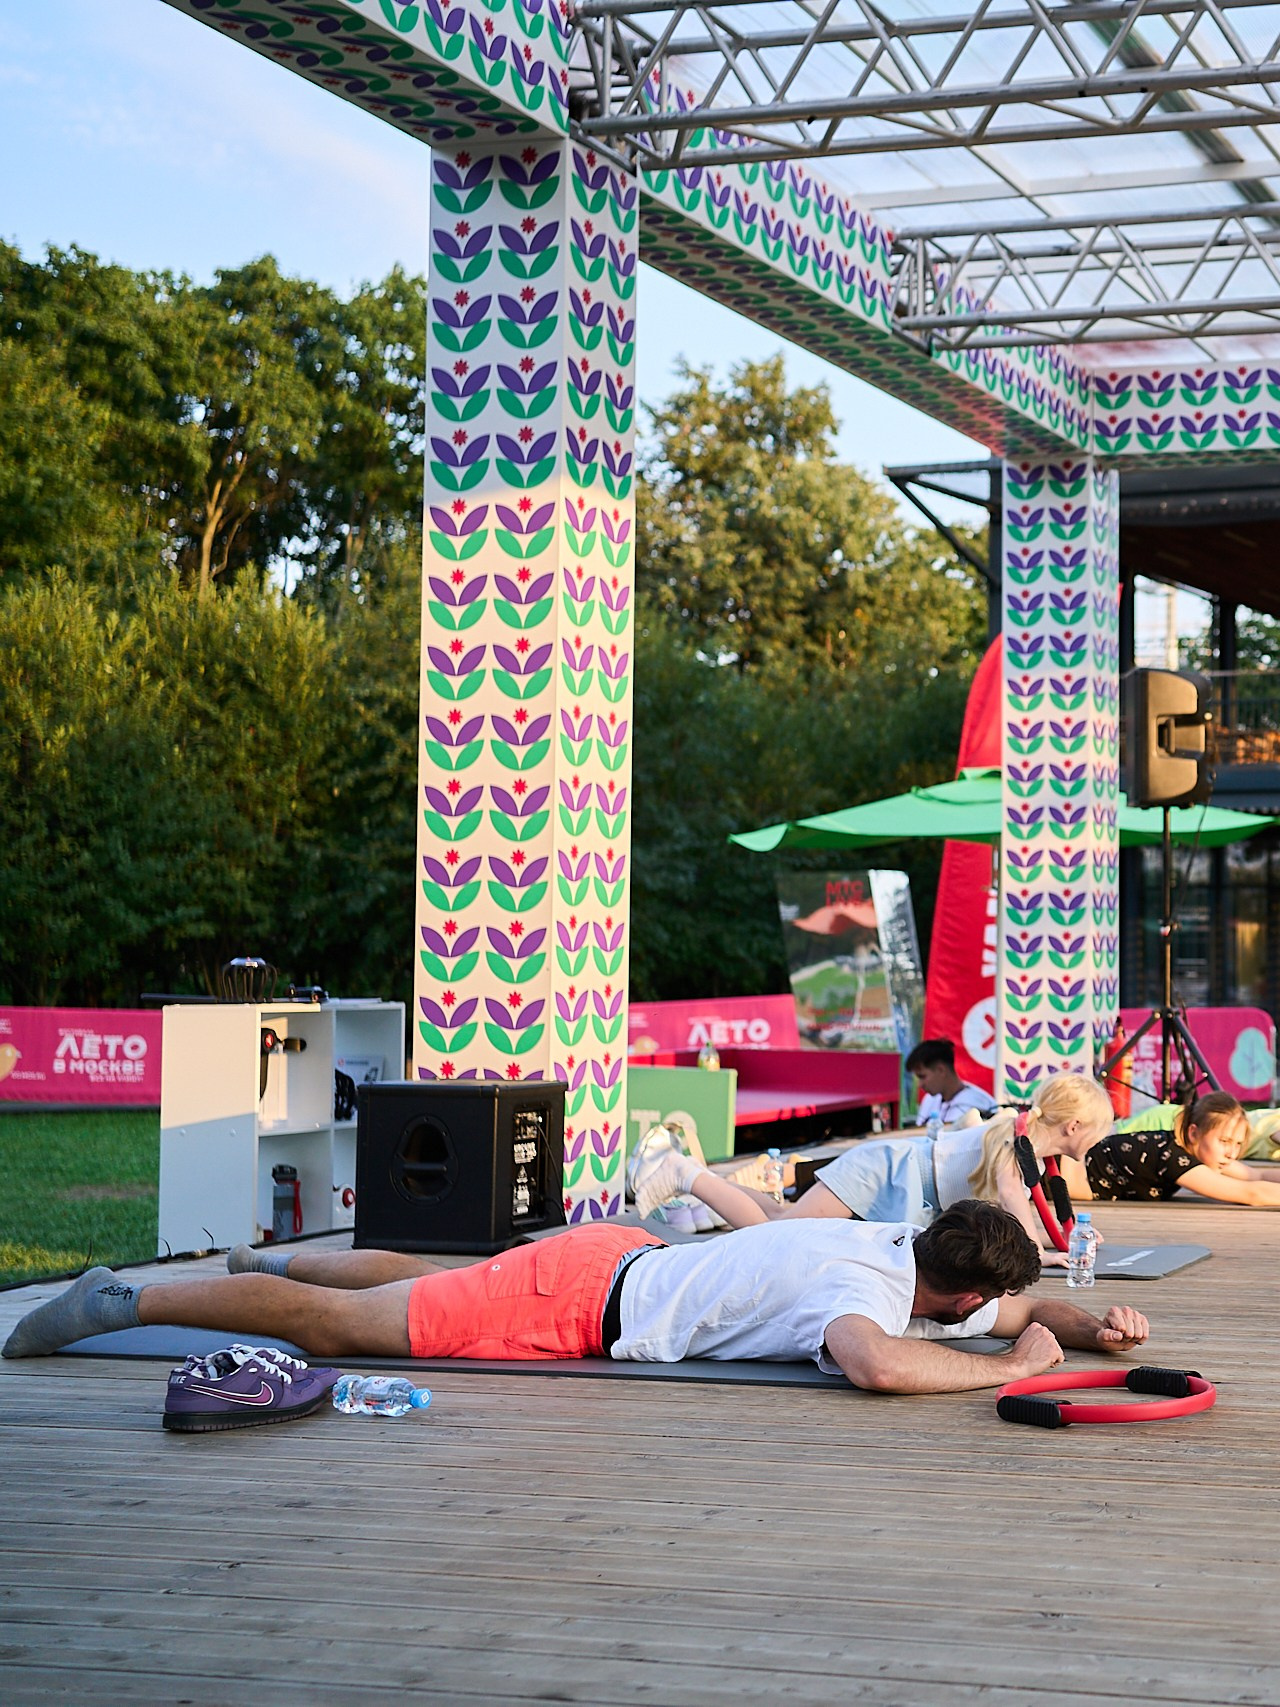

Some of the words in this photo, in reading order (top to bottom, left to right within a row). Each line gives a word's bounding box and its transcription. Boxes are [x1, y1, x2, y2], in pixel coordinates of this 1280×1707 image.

[687, 1018, 771, 1046] ЛЕТО
[56, 1033, 148, 1060] ЛЕТО
[53, 1058, 66, 1074] В
[69, 1059, 145, 1075] МОСКВЕ
